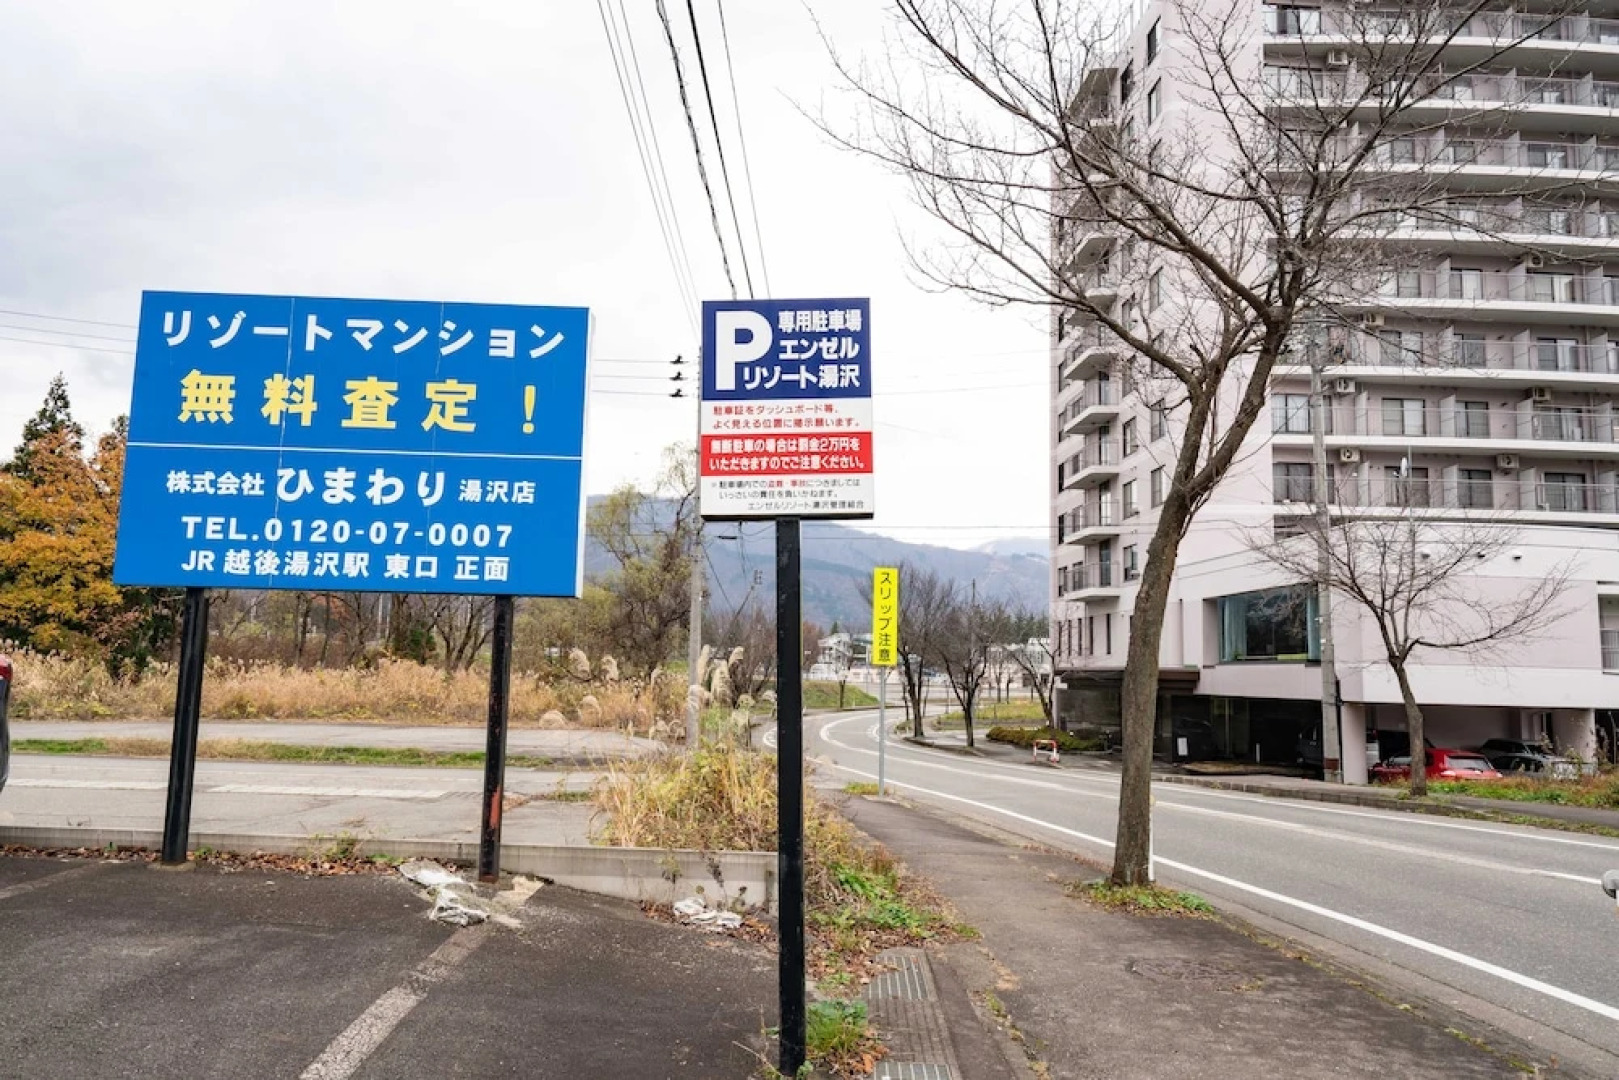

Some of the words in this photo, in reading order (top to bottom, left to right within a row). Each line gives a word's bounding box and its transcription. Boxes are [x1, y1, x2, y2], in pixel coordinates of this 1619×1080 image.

[162, 310, 565, 359] リゾートマンション
[778, 309, 862, 333] 専用駐車場
[715, 310, 773, 391] P
[779, 337, 860, 360] エンゼル
[166, 471, 266, 496] 株式会社
[276, 468, 446, 506] ひまわり
[459, 480, 537, 504] 湯沢店
[181, 516, 513, 547] TEL.0120-07-0007
[181, 550, 215, 572] JR
[223, 551, 370, 579] 越後湯沢駅
[384, 554, 439, 579] 東口
[454, 556, 509, 581] 正面
[878, 572, 892, 662] スリップ注意
